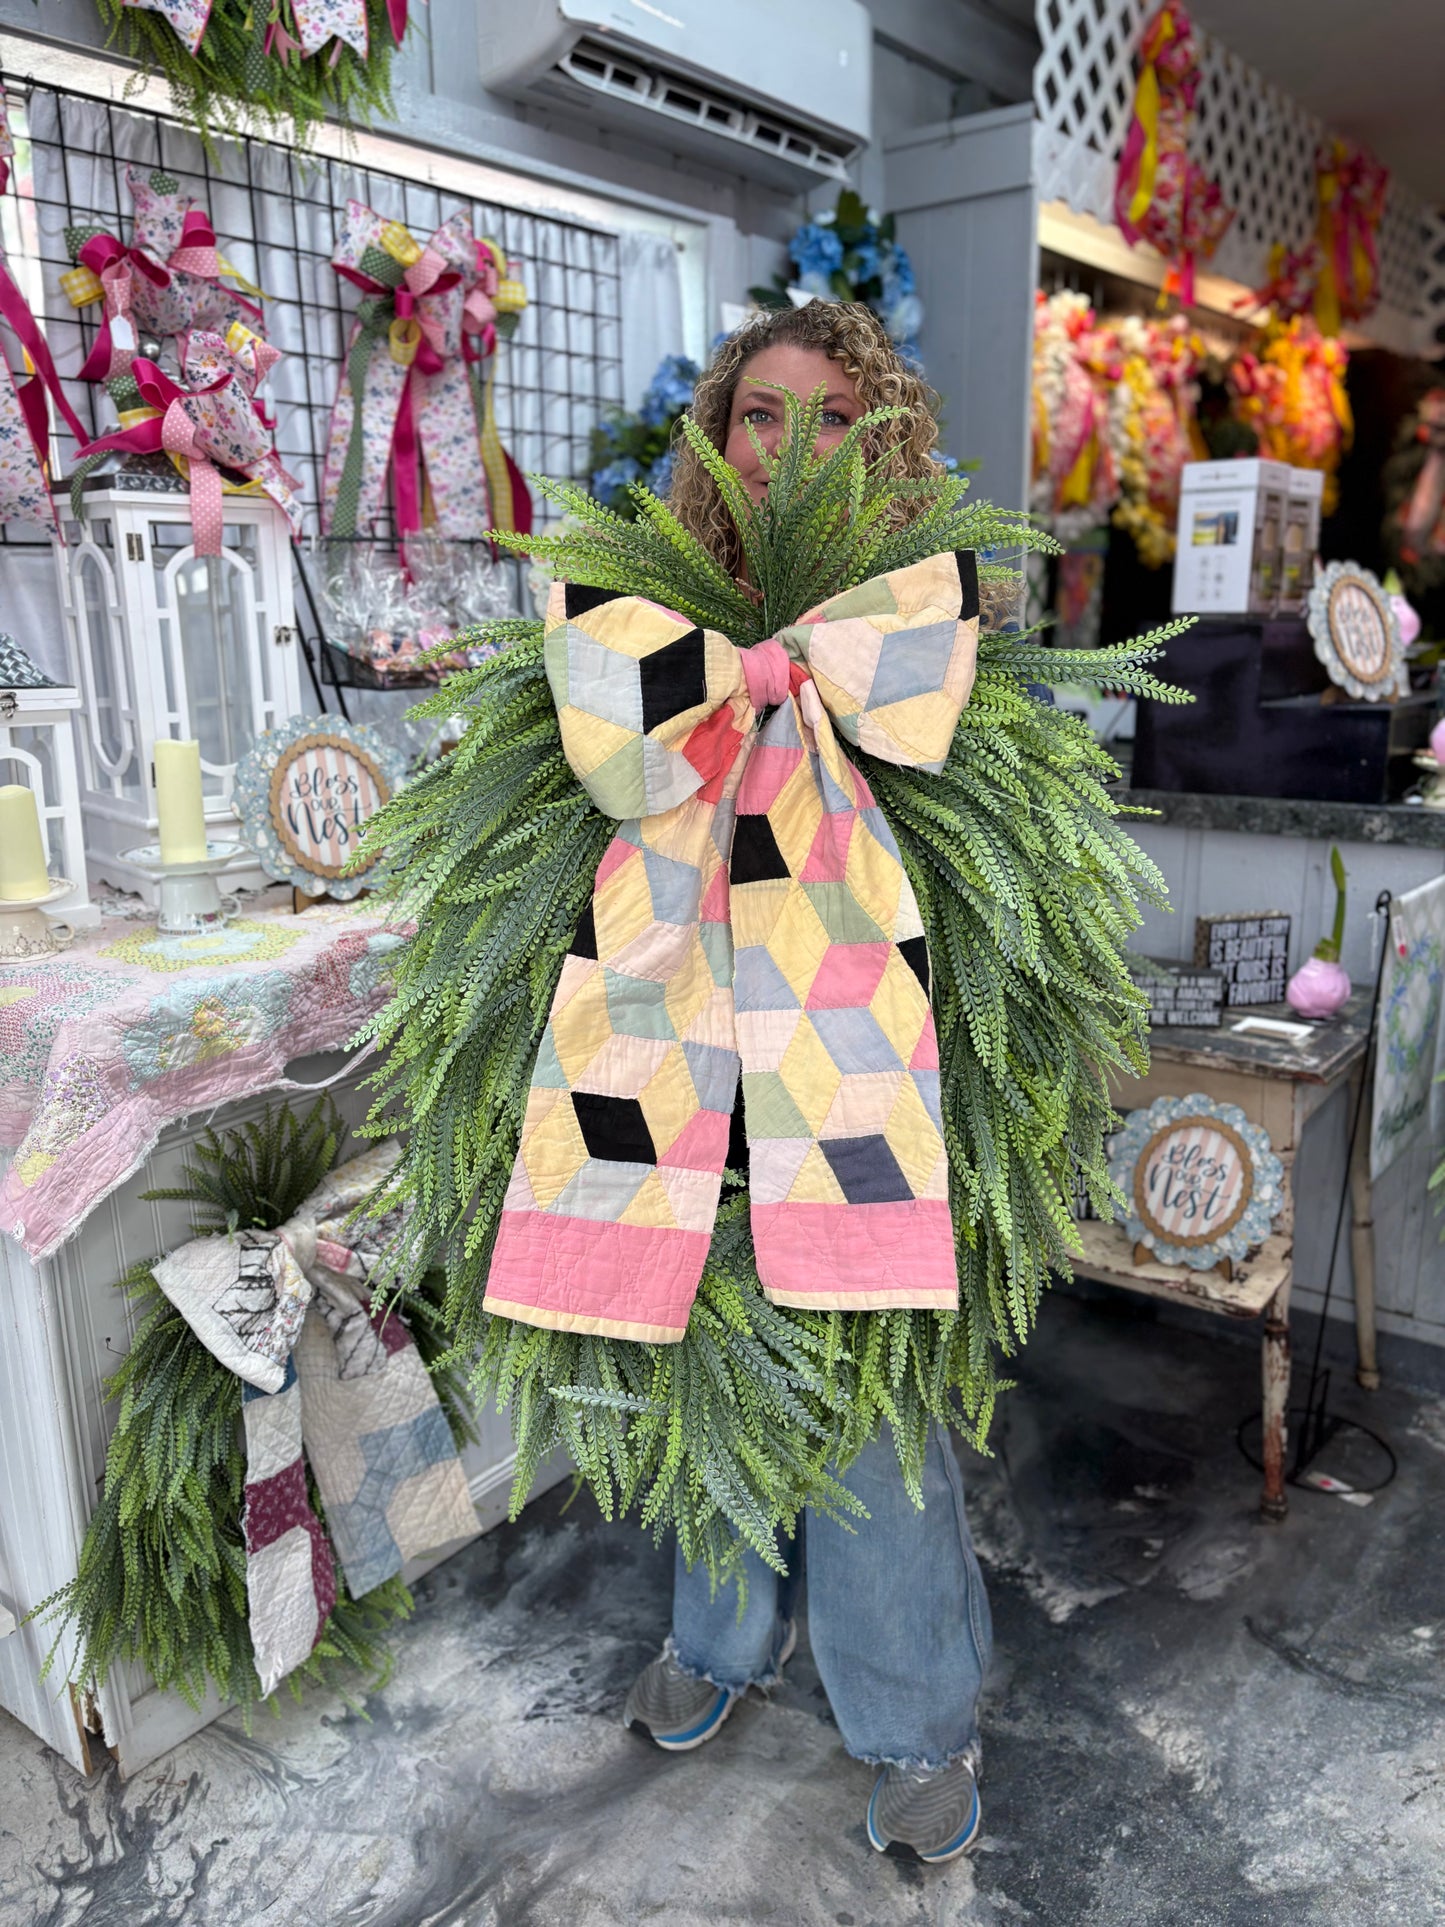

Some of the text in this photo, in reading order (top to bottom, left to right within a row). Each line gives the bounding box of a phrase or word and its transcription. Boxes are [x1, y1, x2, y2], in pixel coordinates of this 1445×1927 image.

[289, 767, 358, 798] Bless
[287, 798, 372, 845] Nest
[1209, 936, 1287, 962] IS BEAUTIFUL
[1237, 959, 1270, 982] OURS
[1270, 957, 1285, 980] IS
[1228, 980, 1284, 1005] FAVORITE
[1167, 1010, 1221, 1025] WELCOME
[1161, 1144, 1228, 1182] Bless
[1150, 1164, 1230, 1221] Nest
